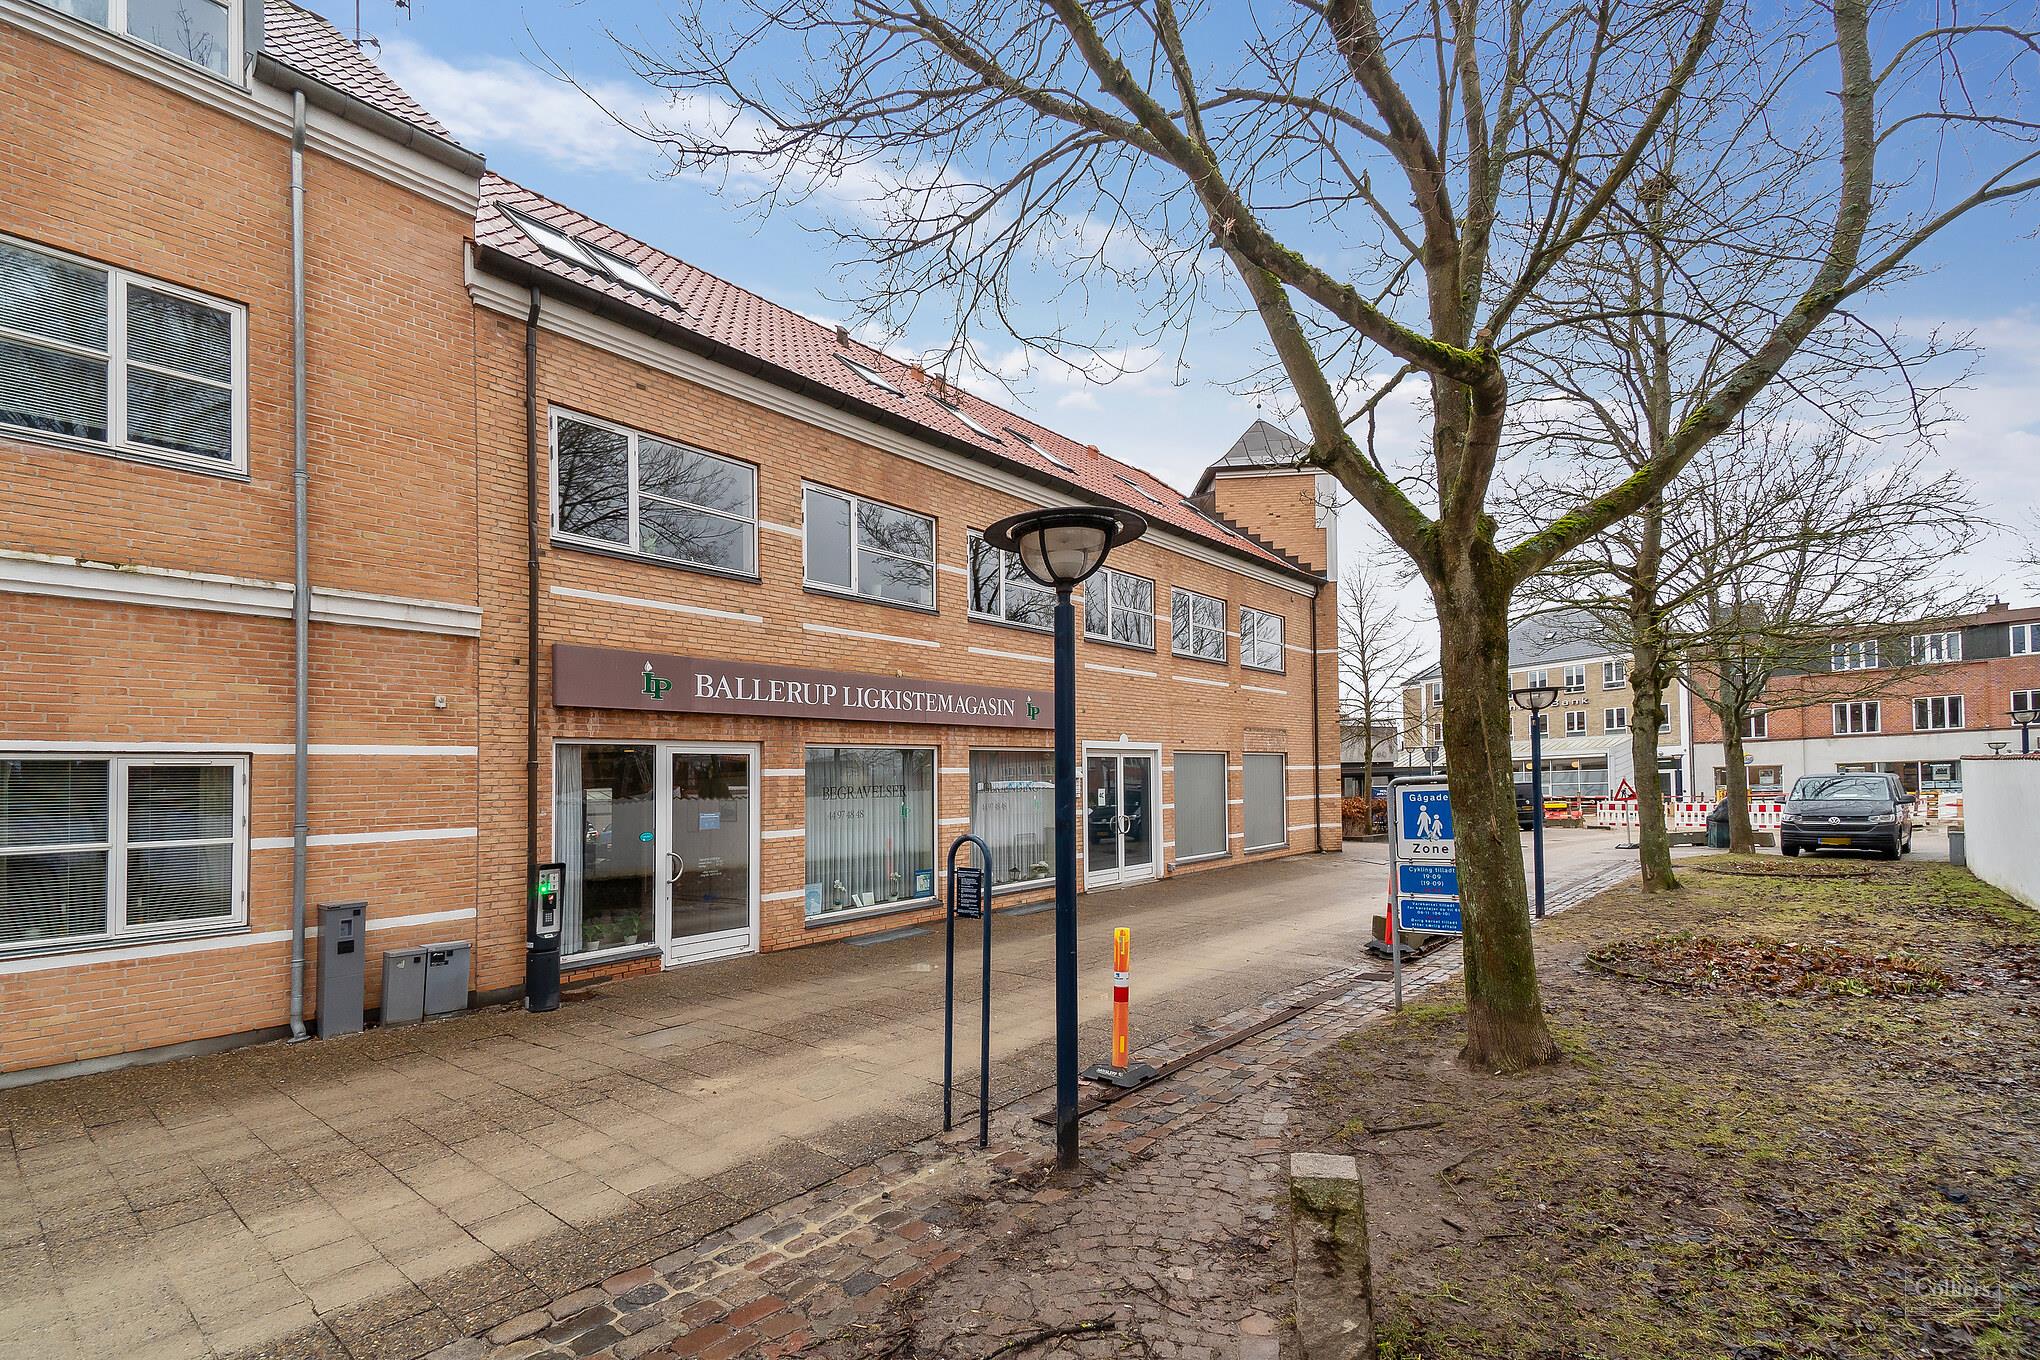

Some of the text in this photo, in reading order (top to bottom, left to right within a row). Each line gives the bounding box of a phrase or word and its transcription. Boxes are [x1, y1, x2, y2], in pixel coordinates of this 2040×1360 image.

[694, 673, 1016, 717] BALLERUP LIGKISTEMAGASIN
[822, 784, 906, 801] BEGRAVELSER
[1409, 793, 1449, 803] Gågade
[1412, 843, 1449, 854] Zone
